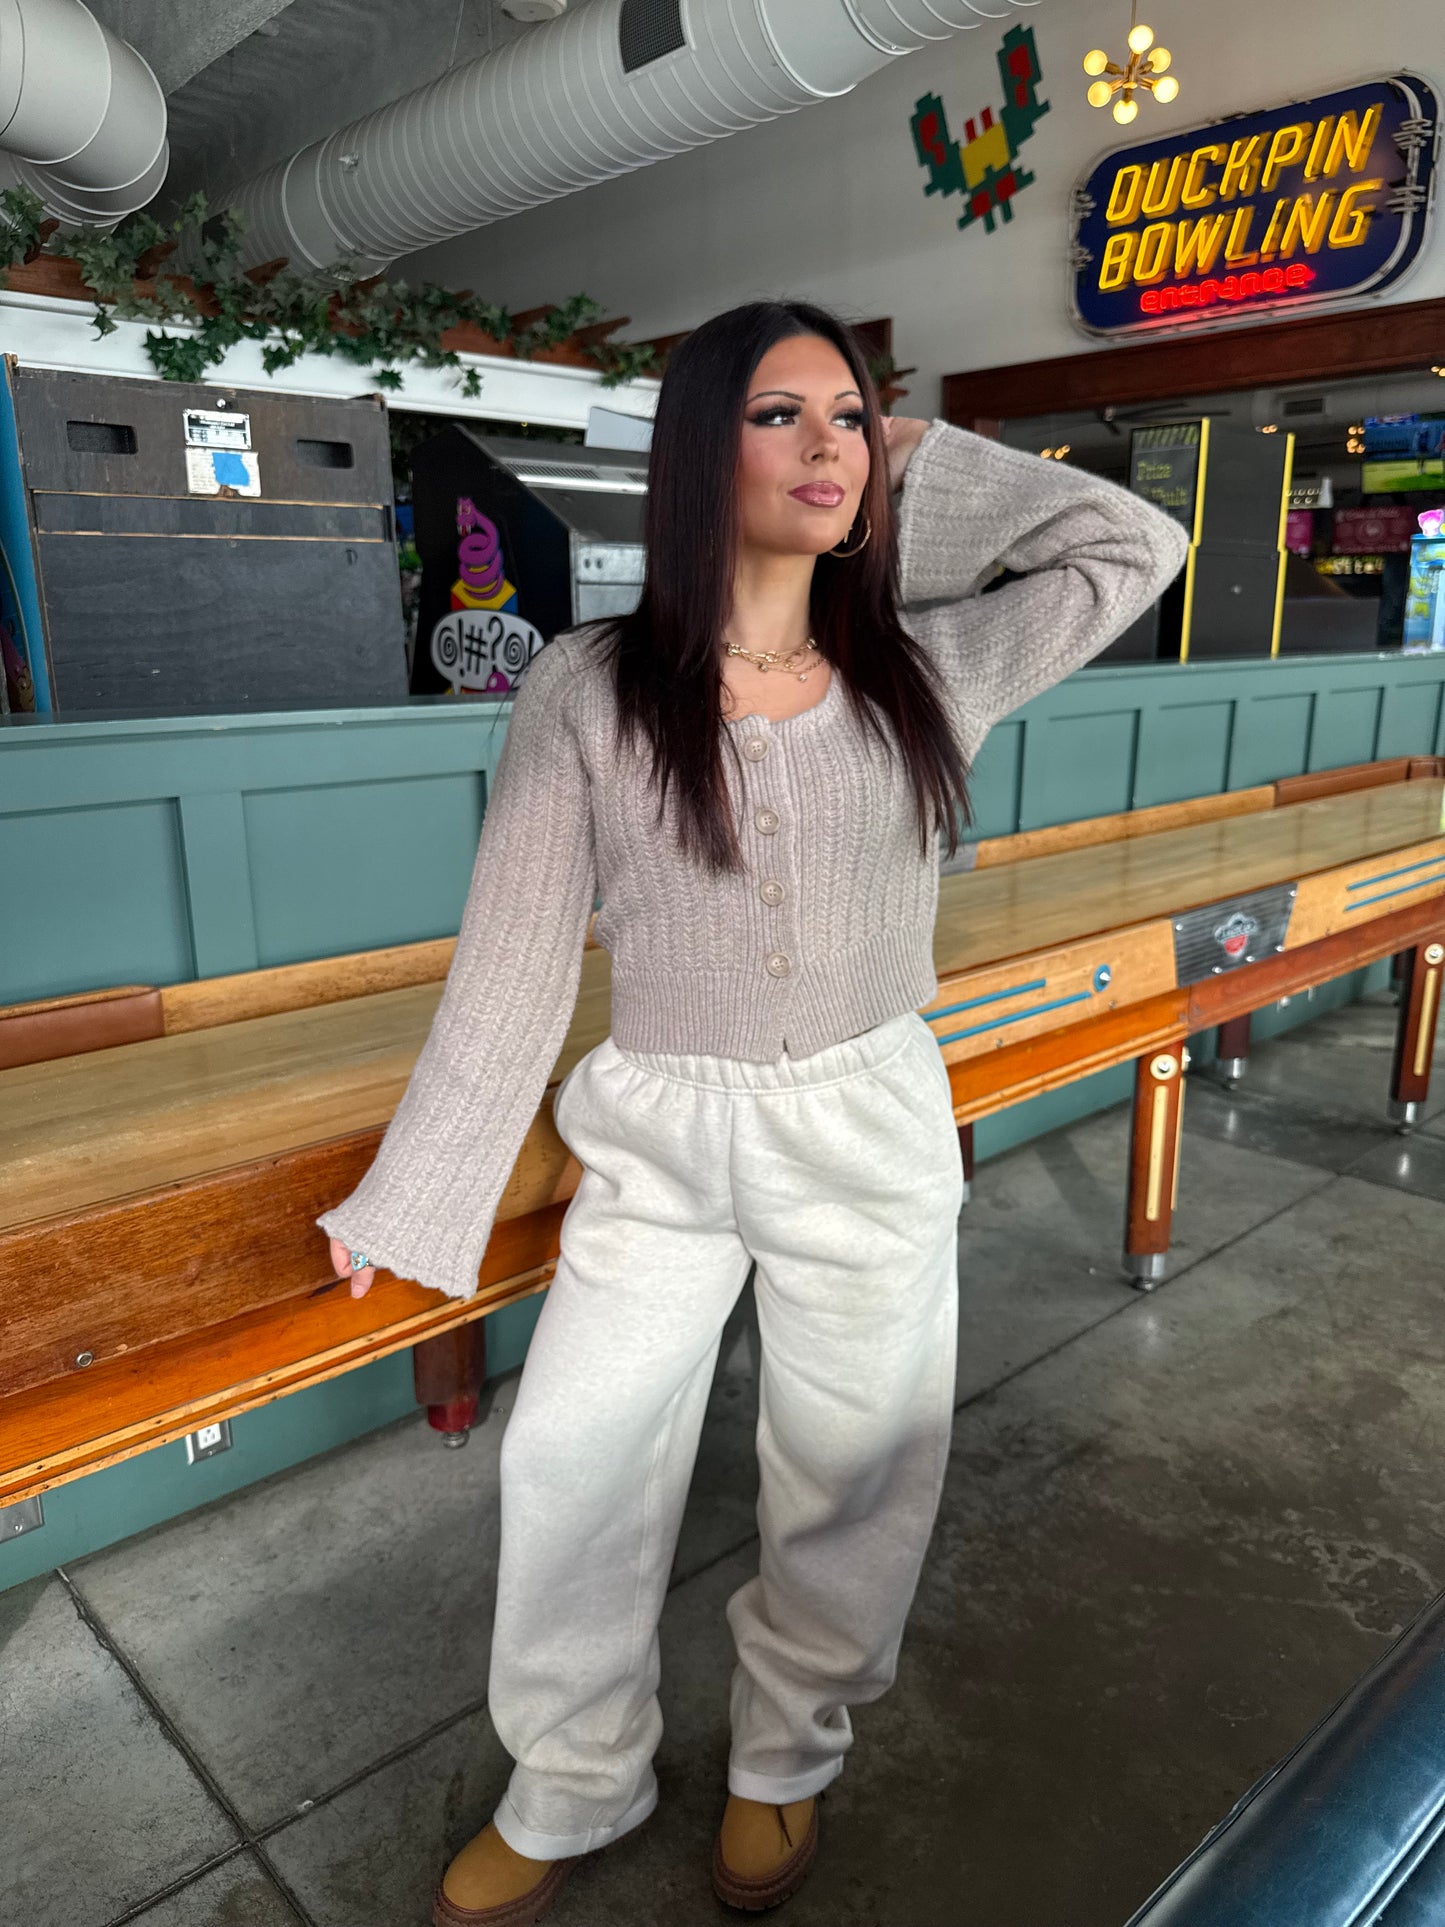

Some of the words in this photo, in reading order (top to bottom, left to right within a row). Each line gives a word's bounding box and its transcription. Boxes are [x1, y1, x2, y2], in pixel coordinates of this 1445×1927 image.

[1105, 103, 1384, 227] DUCKPIN
[1098, 178, 1384, 294] BOWLING
[1139, 263, 1315, 314] entrance
